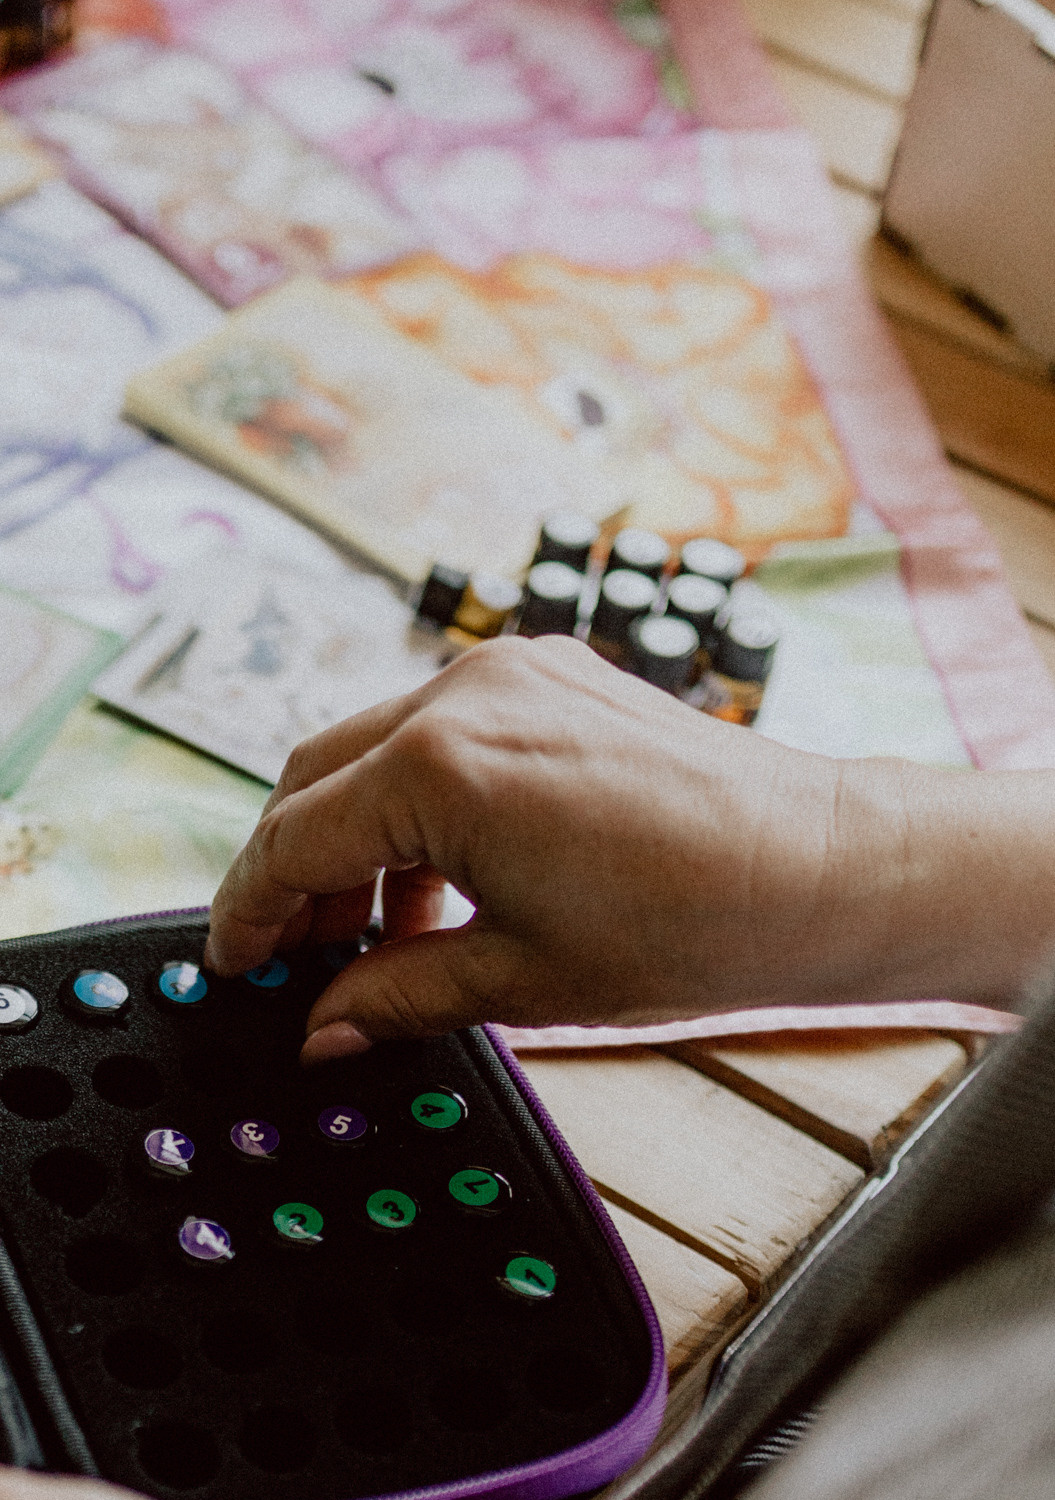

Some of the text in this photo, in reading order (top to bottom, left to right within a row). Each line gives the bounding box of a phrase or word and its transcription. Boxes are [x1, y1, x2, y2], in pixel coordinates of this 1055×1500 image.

[420, 1104, 446, 1118] 4
[243, 1123, 264, 1142] 3
[330, 1115, 352, 1134] 5
[383, 1201, 404, 1222] 3
[525, 1269, 547, 1288] 1
